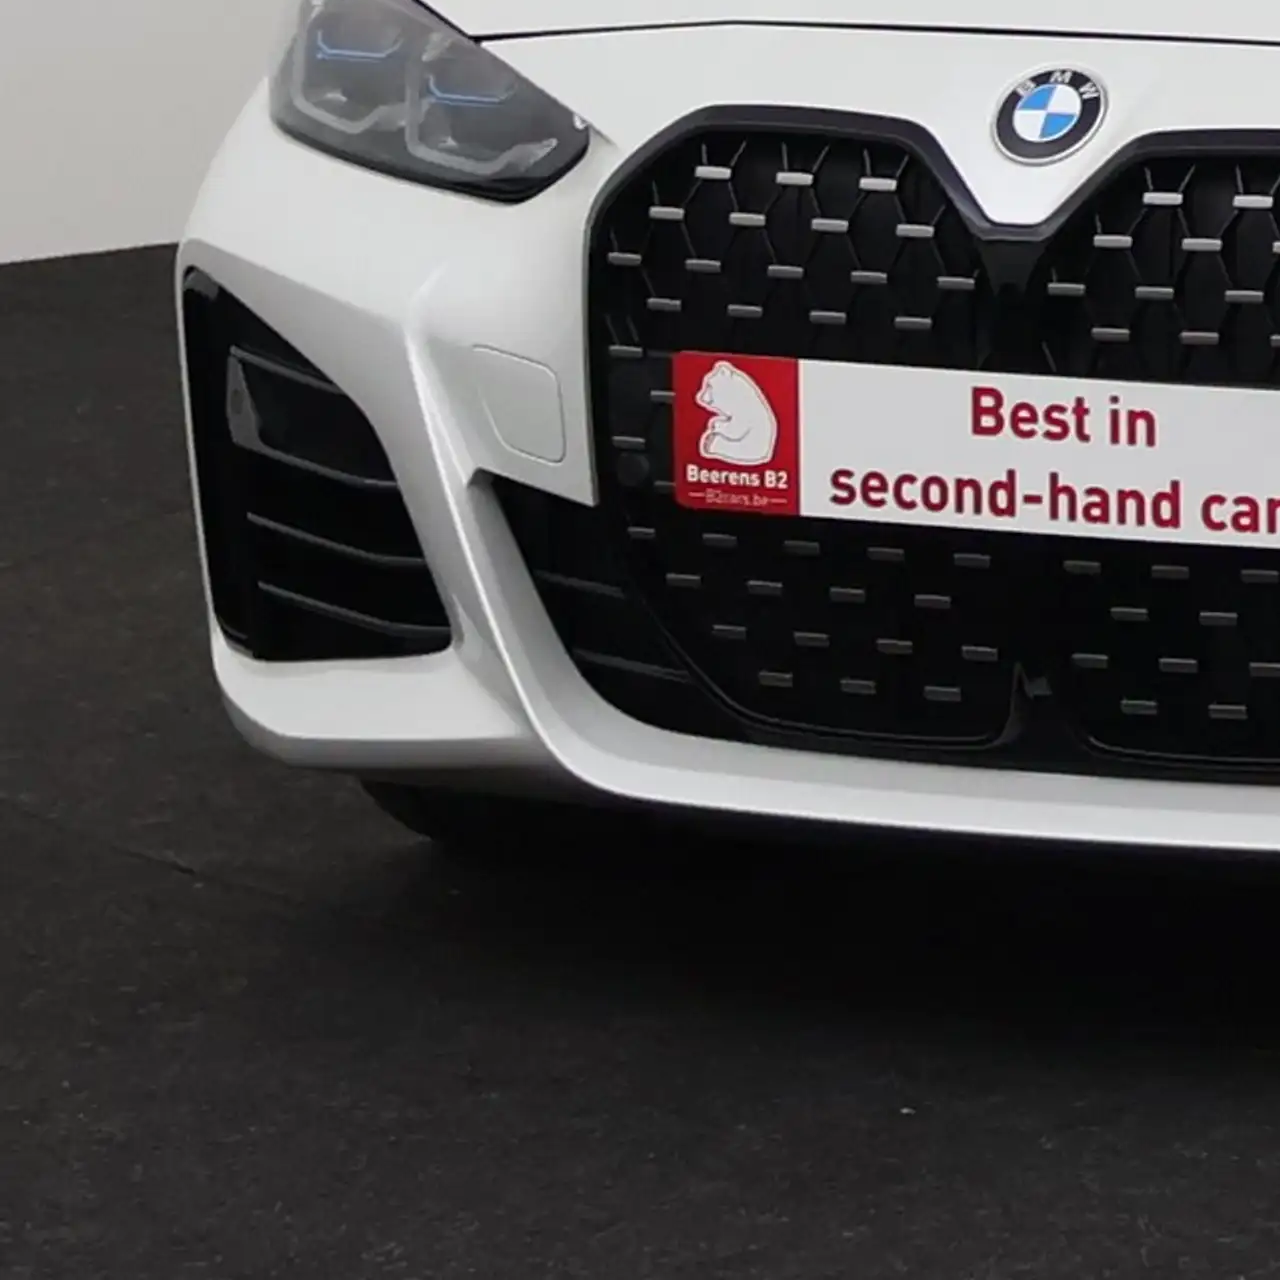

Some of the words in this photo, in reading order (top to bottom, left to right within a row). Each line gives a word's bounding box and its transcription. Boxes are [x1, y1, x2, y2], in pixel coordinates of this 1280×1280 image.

[1015, 70, 1100, 99] BMW
[971, 385, 1092, 442] Best
[1109, 395, 1157, 448] in
[686, 464, 760, 487] Beerens
[764, 470, 788, 489] B2
[829, 468, 1182, 530] second-hand
